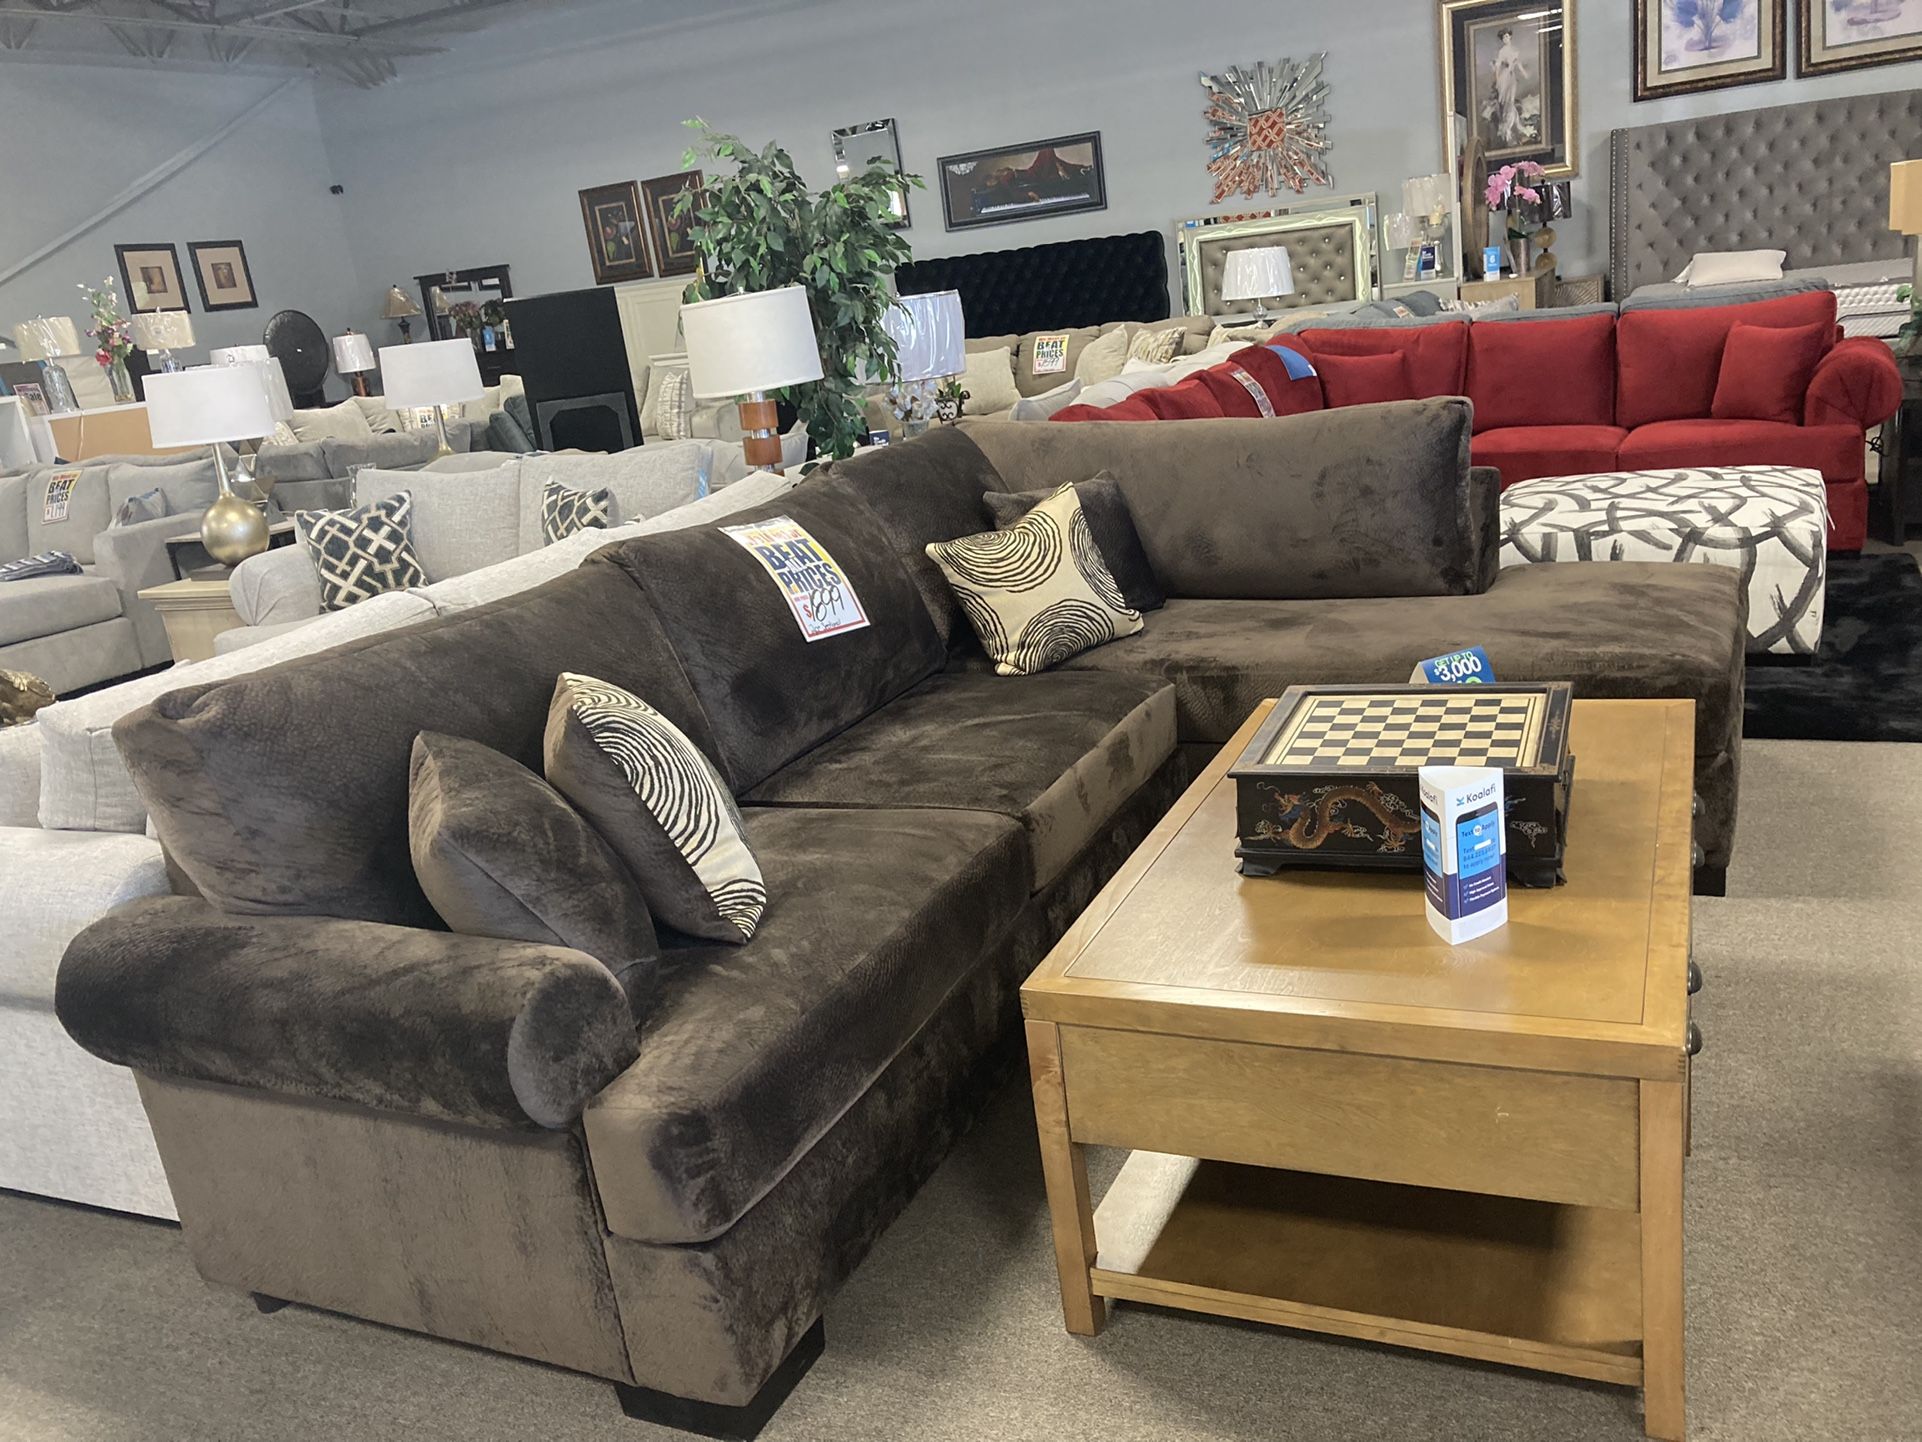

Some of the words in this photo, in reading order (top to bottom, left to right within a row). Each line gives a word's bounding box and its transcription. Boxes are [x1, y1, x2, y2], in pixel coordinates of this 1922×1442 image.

[1036, 348, 1064, 359] PRICES
[1037, 340, 1065, 350] BEAT
[48, 479, 75, 494] BEAT
[753, 538, 823, 571] BEAT
[777, 562, 842, 595] PRICES
[1434, 656, 1450, 668] GET
[1450, 654, 1461, 663] UP
[1461, 650, 1473, 660] TO
[1434, 655, 1482, 682] $3,000
[1466, 783, 1497, 804] Koalafi
